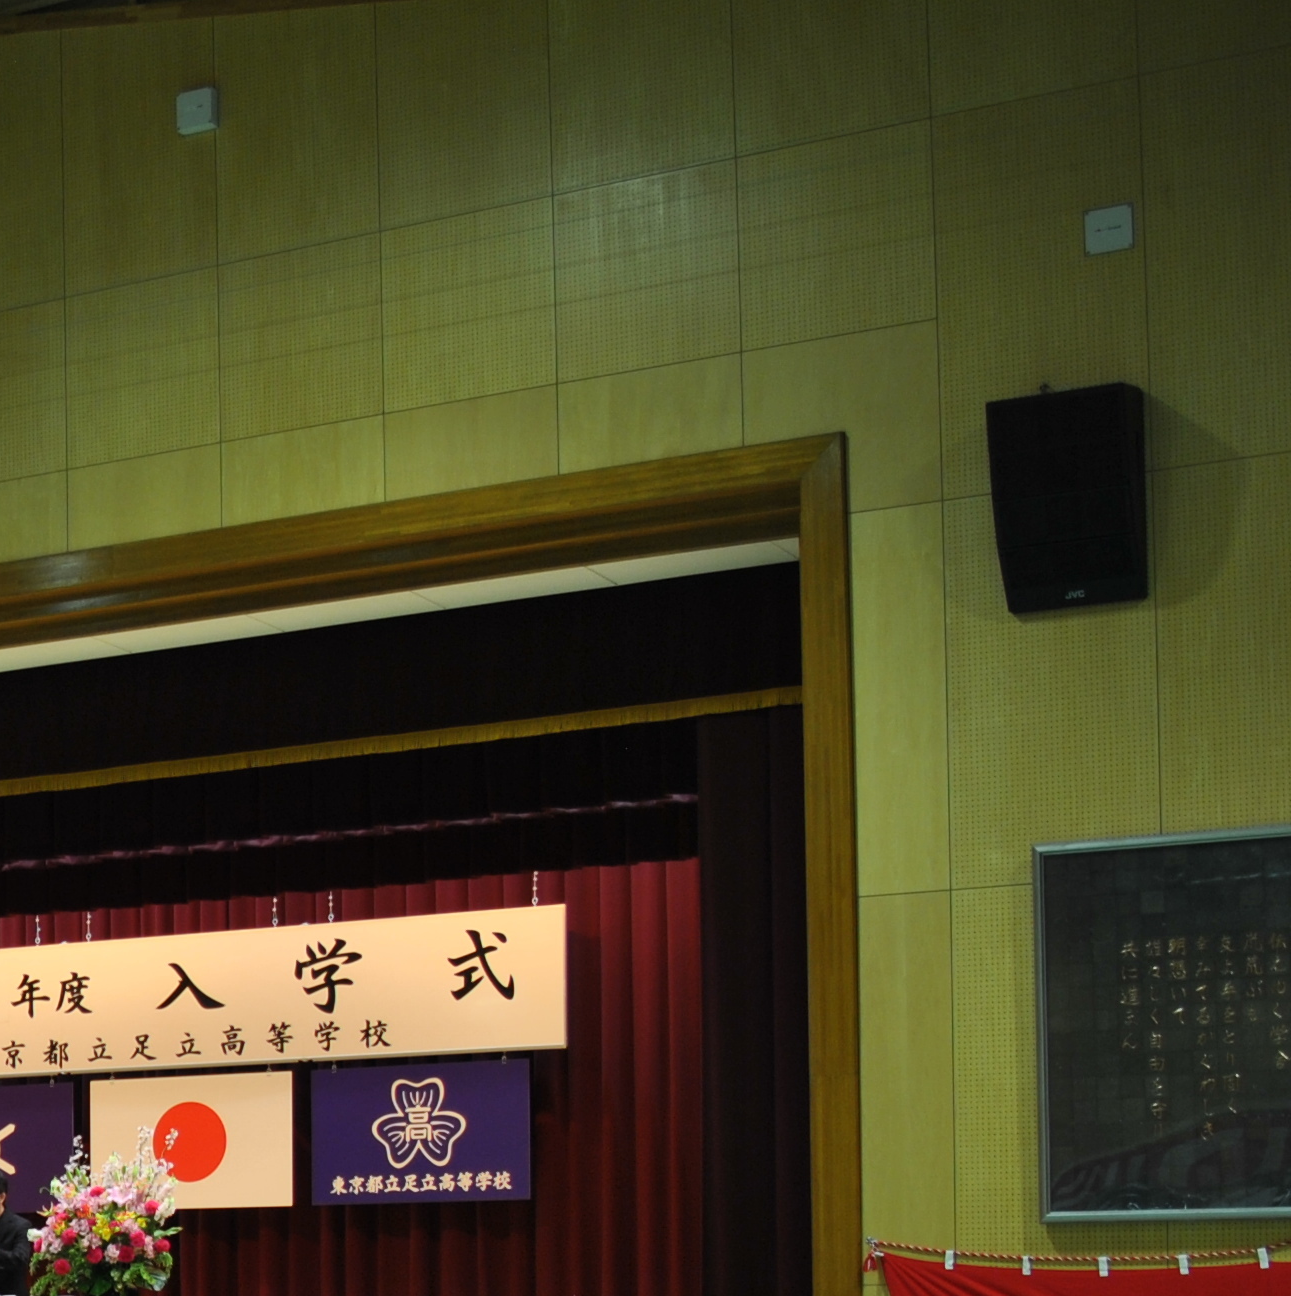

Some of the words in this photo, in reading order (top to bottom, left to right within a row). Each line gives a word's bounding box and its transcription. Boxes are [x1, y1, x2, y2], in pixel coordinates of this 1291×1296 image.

[1065, 590, 1085, 599] JVC
[155, 929, 515, 1014] 入学式
[330, 1171, 512, 1195] 東京都立足立高等学校
